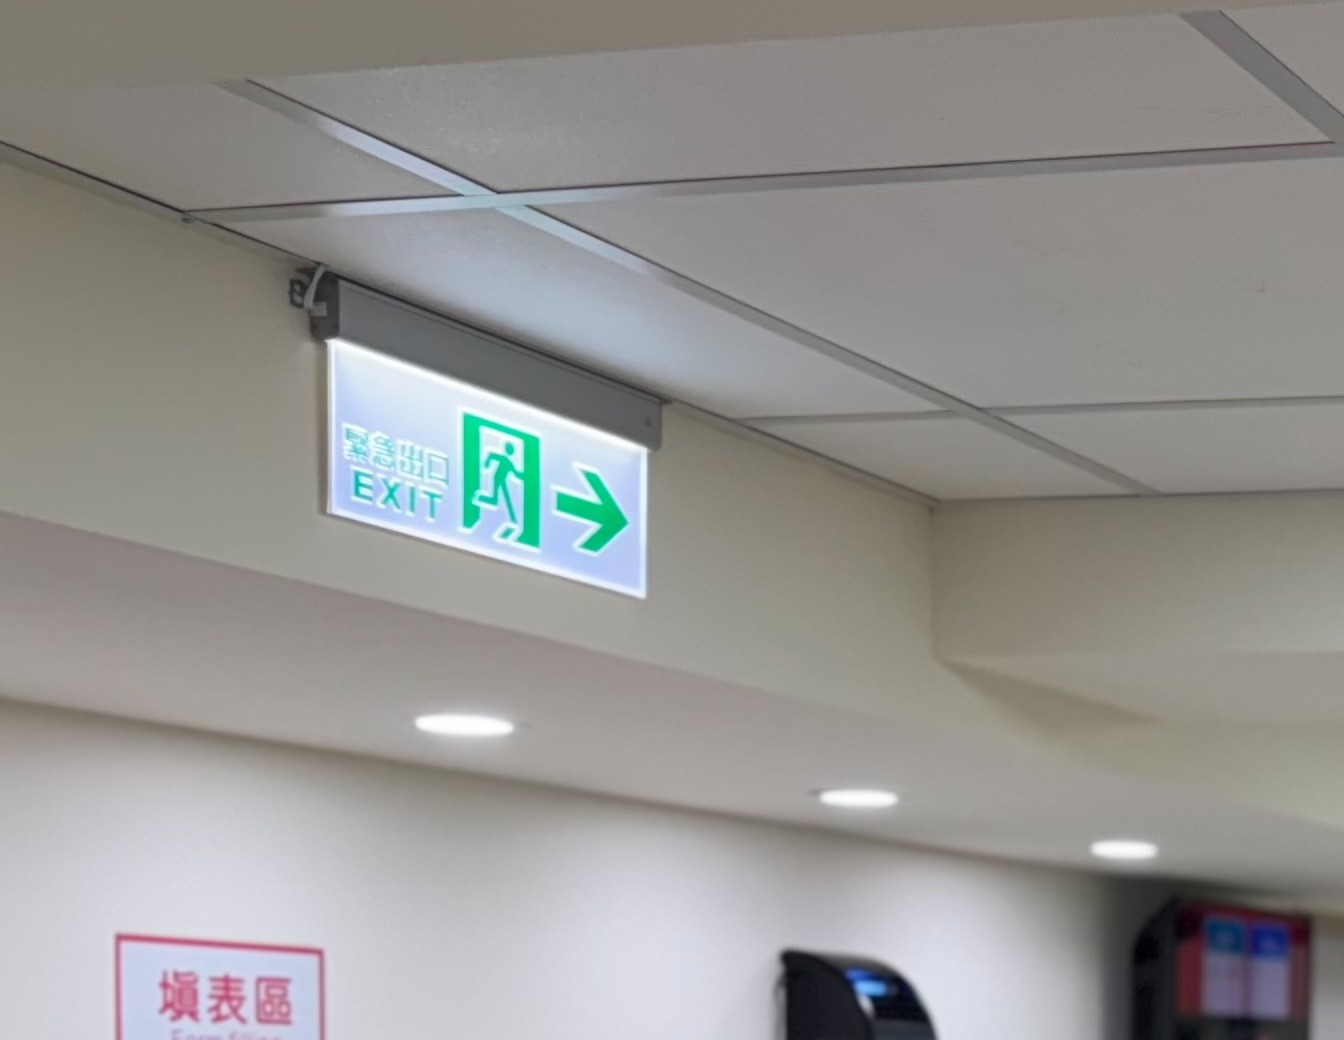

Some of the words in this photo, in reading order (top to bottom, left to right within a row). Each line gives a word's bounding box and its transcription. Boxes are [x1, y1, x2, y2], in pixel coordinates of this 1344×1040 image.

[343, 423, 447, 487] 緊急出口
[352, 468, 443, 521] EXIT
